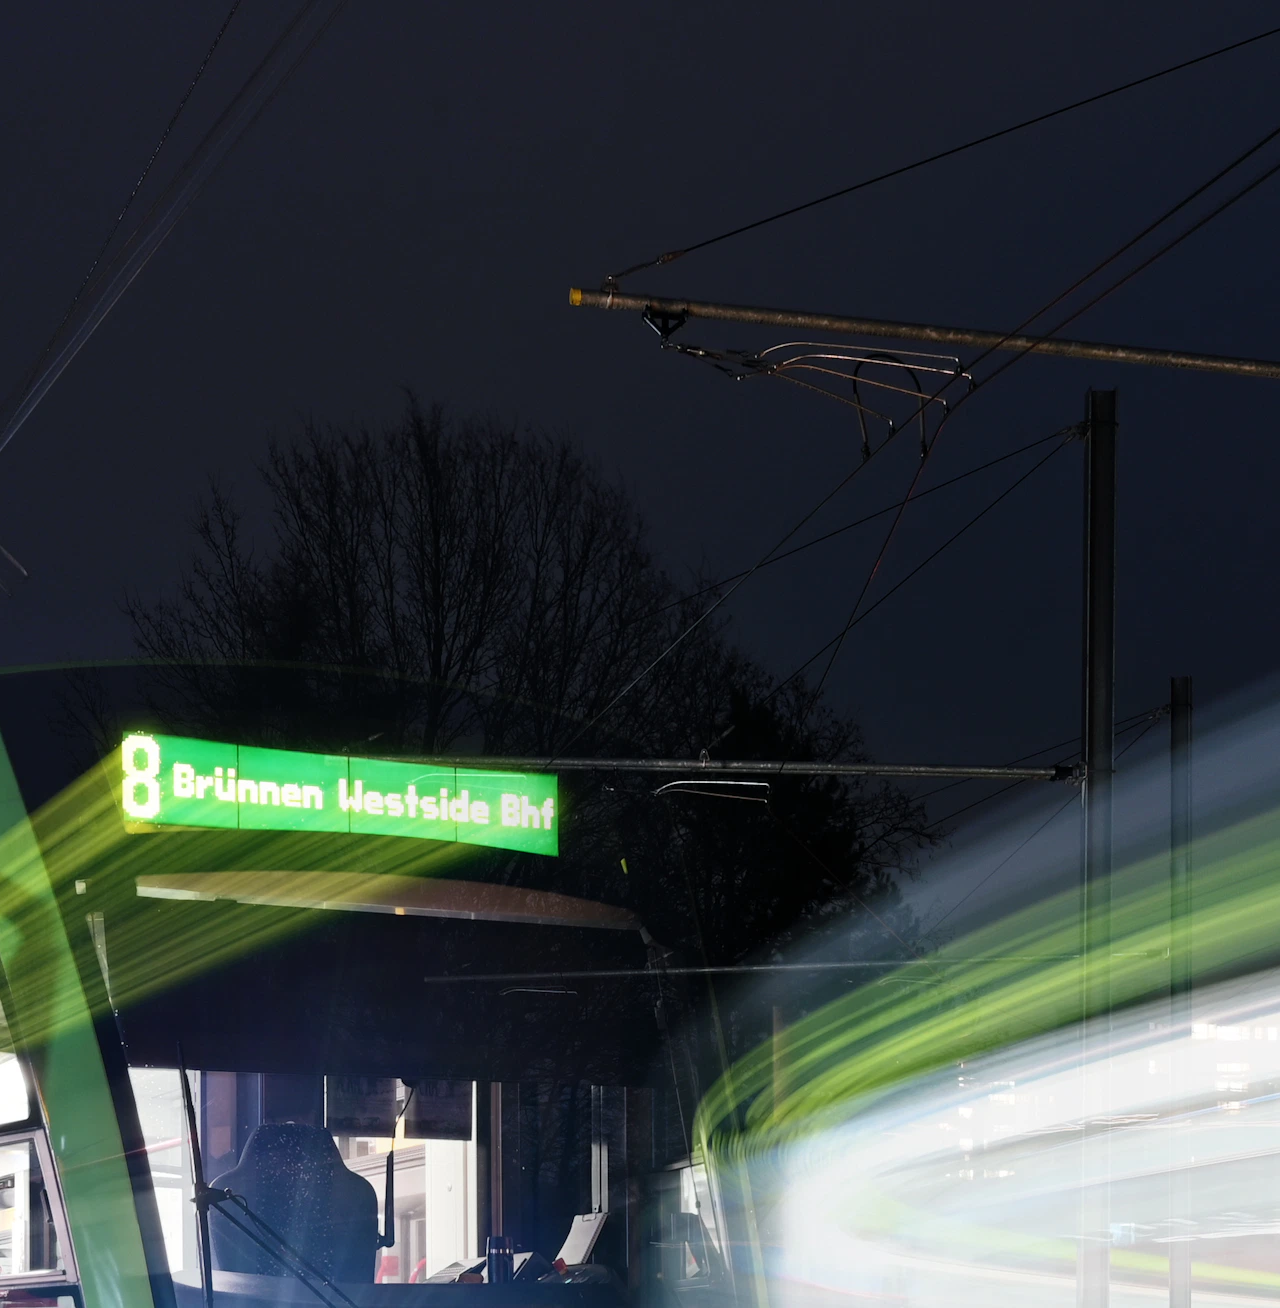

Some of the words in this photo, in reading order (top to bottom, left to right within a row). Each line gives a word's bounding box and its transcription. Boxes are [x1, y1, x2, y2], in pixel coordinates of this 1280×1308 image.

[121, 732, 160, 819] 8
[173, 762, 322, 809] Brünnen
[338, 778, 489, 824] Westside
[500, 794, 555, 830] Bhf
